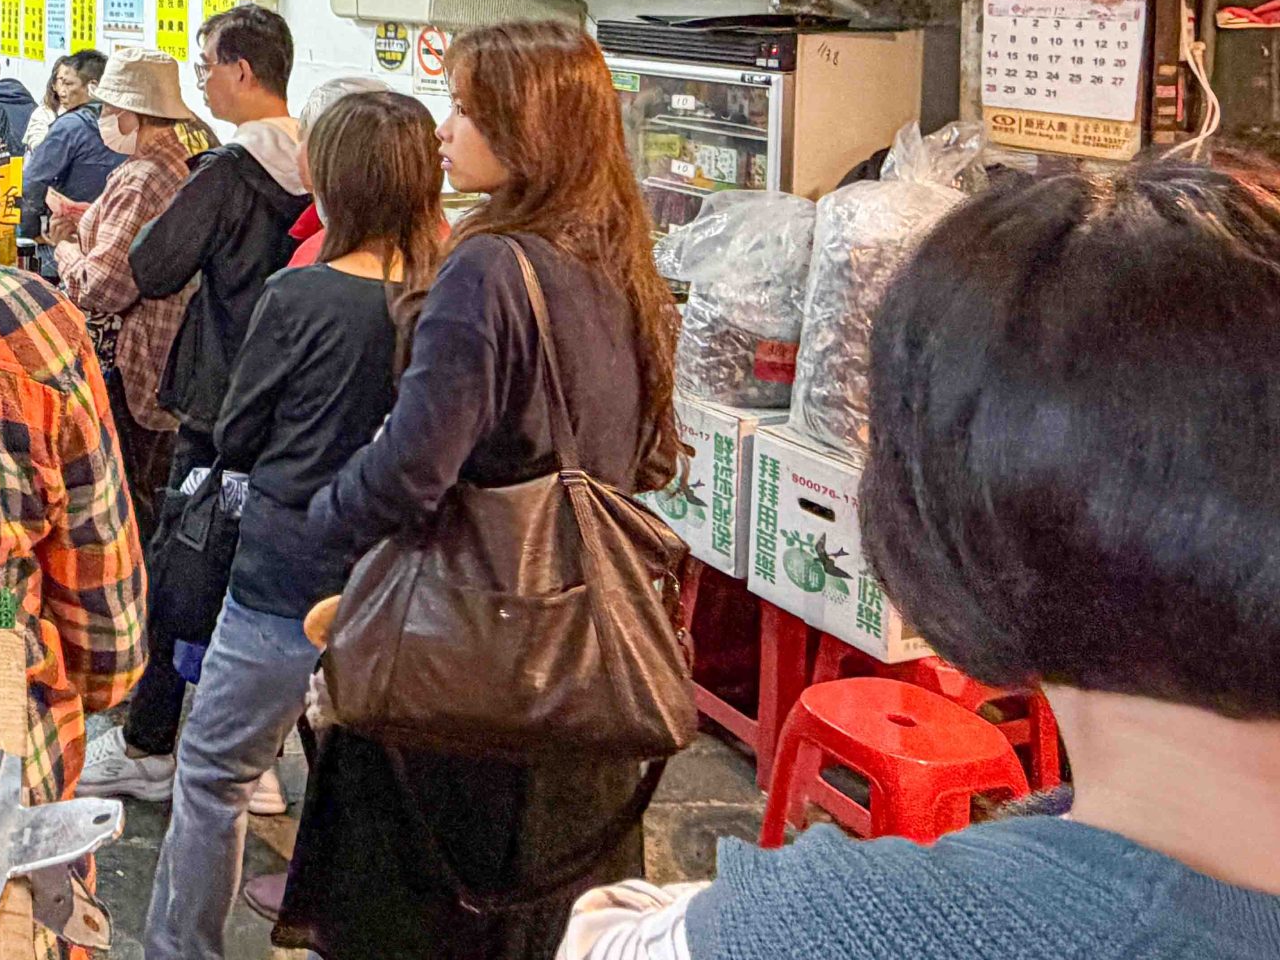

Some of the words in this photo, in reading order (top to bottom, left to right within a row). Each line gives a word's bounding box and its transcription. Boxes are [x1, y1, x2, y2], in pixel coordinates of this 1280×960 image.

[1054, 20, 1060, 28] 3
[991, 34, 997, 42] 7
[1095, 40, 1107, 48] 12
[1008, 52, 1018, 60] 15
[1027, 54, 1039, 62] 16
[1049, 55, 1061, 63] 17
[1071, 56, 1083, 64] 18
[1093, 58, 1105, 66] 19
[1114, 59, 1126, 67] 20
[1005, 69, 1017, 77] 22
[1090, 75, 1103, 83] 26
[1112, 77, 1124, 85] 27
[1004, 86, 1015, 94] 29
[1024, 87, 1036, 95] 30
